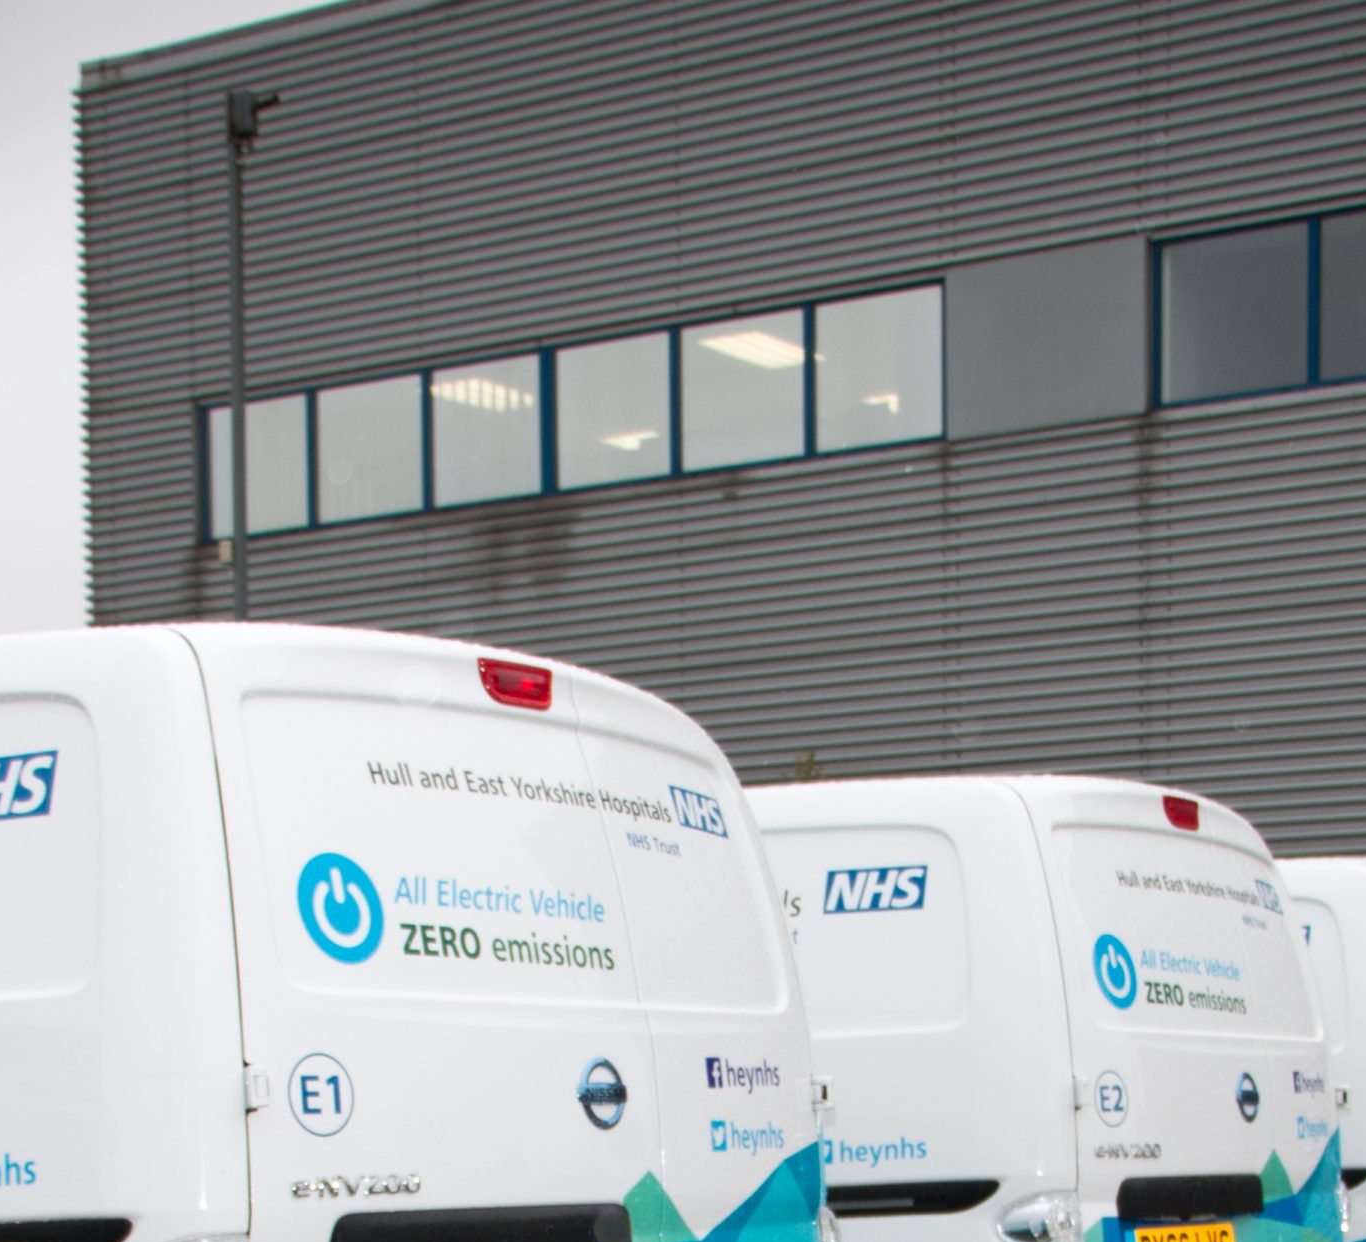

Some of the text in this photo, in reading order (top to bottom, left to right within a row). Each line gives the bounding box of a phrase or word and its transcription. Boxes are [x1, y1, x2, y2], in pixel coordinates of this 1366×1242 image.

[367, 762, 673, 823] Hull and East Yorkshire Hospitals
[671, 786, 727, 838] NHS
[627, 832, 681, 858] NHS Trust
[394, 876, 605, 923] All Electric Vehicle
[825, 866, 927, 913] NHS
[399, 923, 615, 971] ZERO emissions
[1141, 949, 1156, 969] All
[1160, 951, 1201, 975] Electric
[1144, 981, 1247, 1014] ZERO emissions
[725, 1058, 780, 1094] heynhs
[299, 1074, 343, 1115] E1
[1099, 1085, 1124, 1113] E2
[731, 1121, 784, 1156] heynhs
[839, 1137, 927, 1168] heynhs
